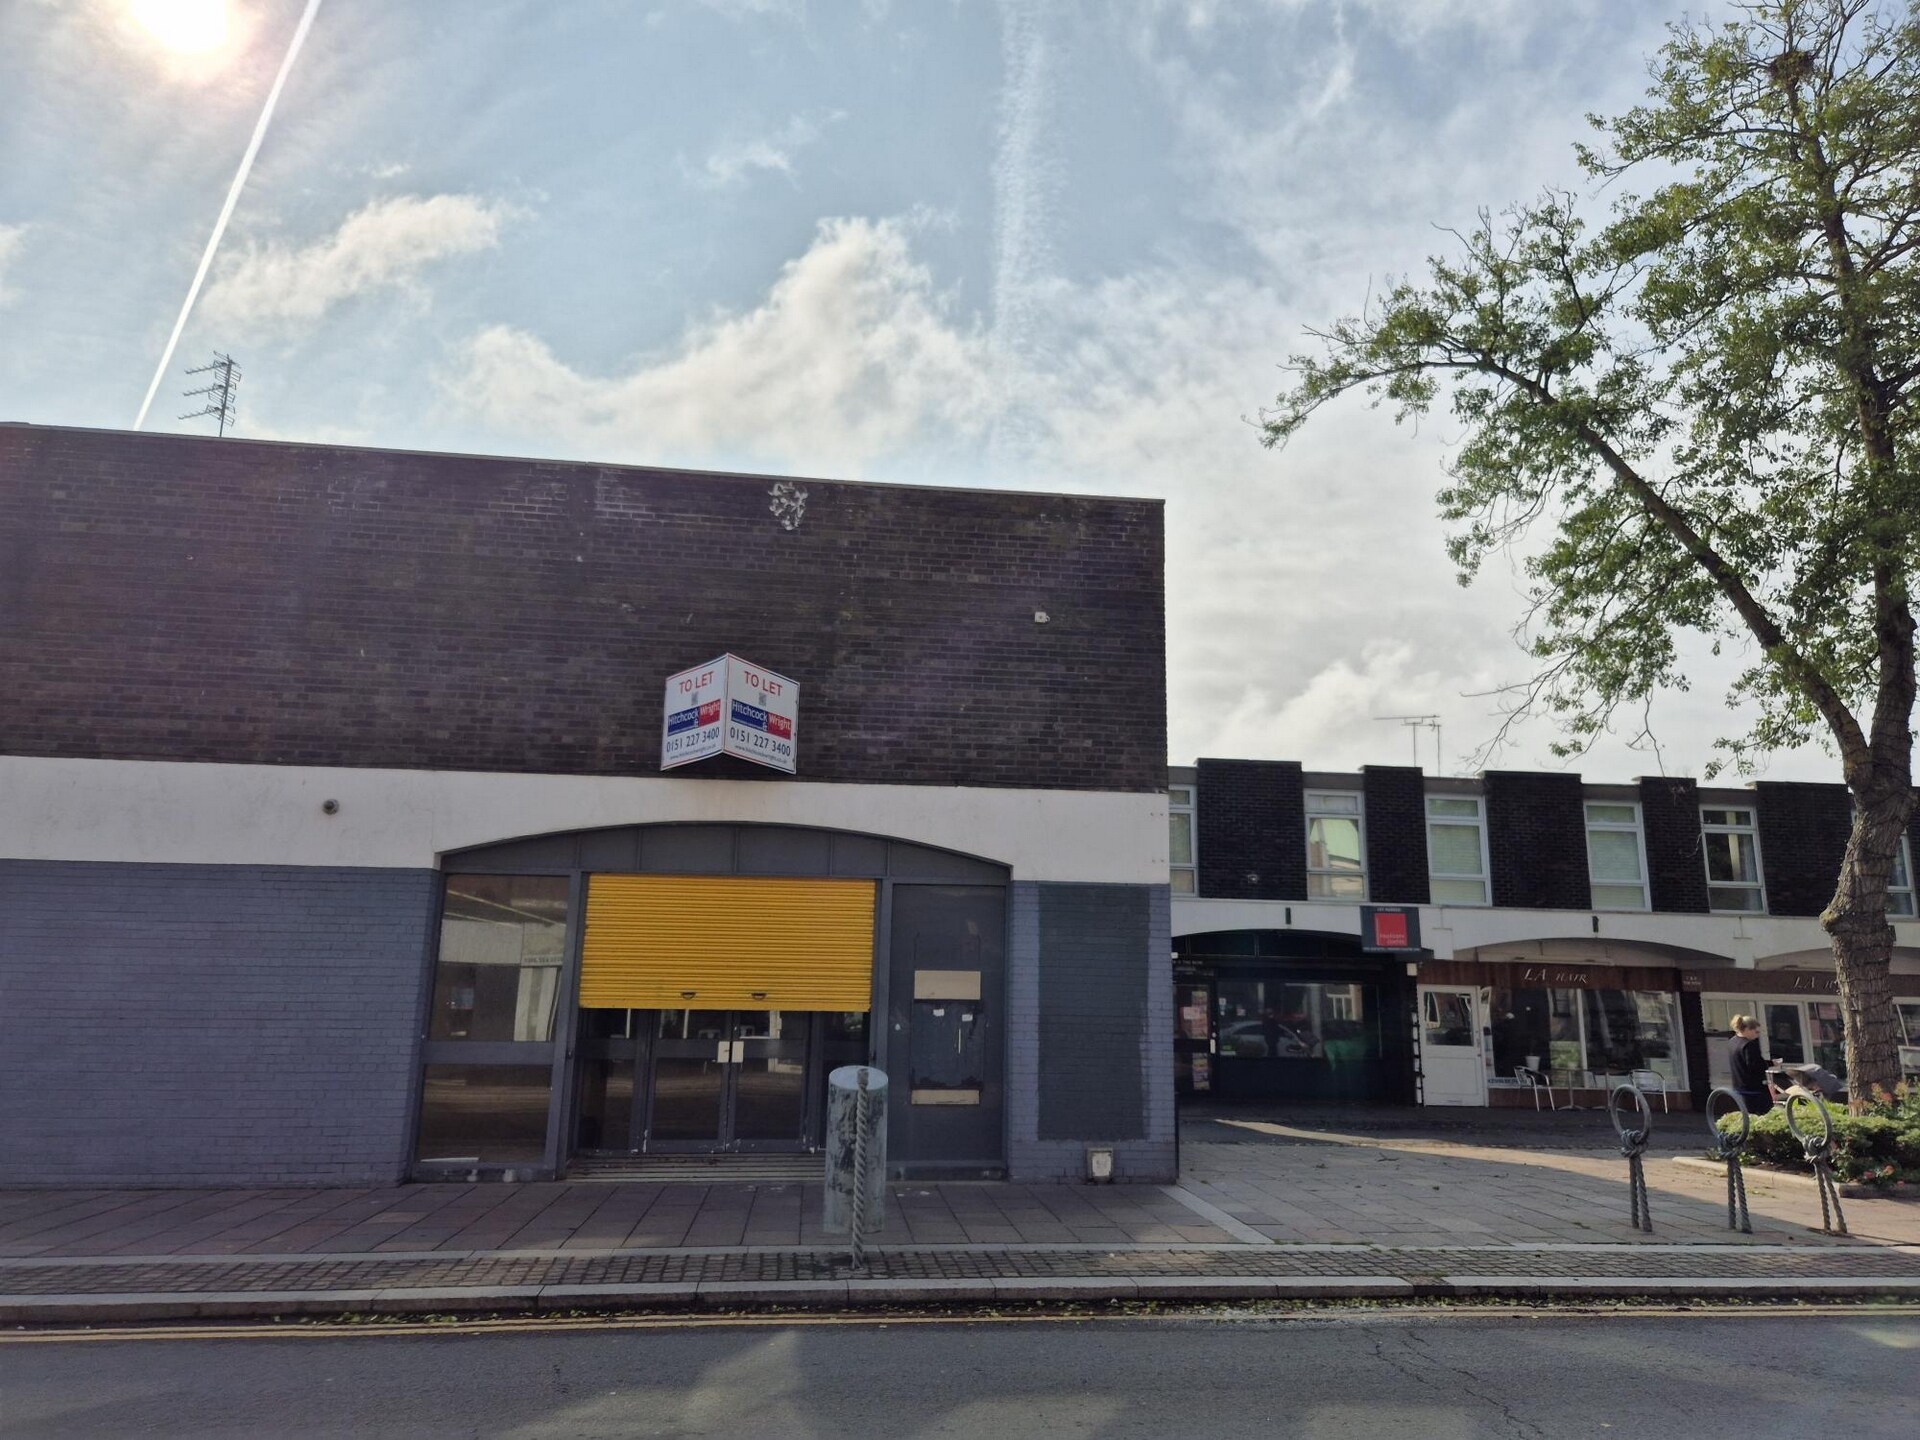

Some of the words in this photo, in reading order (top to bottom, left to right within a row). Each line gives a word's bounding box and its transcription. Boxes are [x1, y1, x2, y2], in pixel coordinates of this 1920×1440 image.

[679, 679, 692, 694] TO
[695, 671, 714, 689] LET
[744, 671, 759, 687] TO
[763, 679, 783, 696] LET
[668, 707, 699, 726] Hitchcock
[700, 701, 721, 717] Wright
[732, 702, 768, 722] Hitchcock
[769, 713, 791, 731] Wright
[667, 739, 682, 752] 0151
[686, 733, 700, 747] 227
[702, 727, 720, 743] 3400
[730, 727, 749, 743] 0151
[754, 735, 768, 749] 227
[772, 742, 790, 757] 3400
[1524, 968, 1546, 981] LA
[1793, 976, 1816, 989] LA
